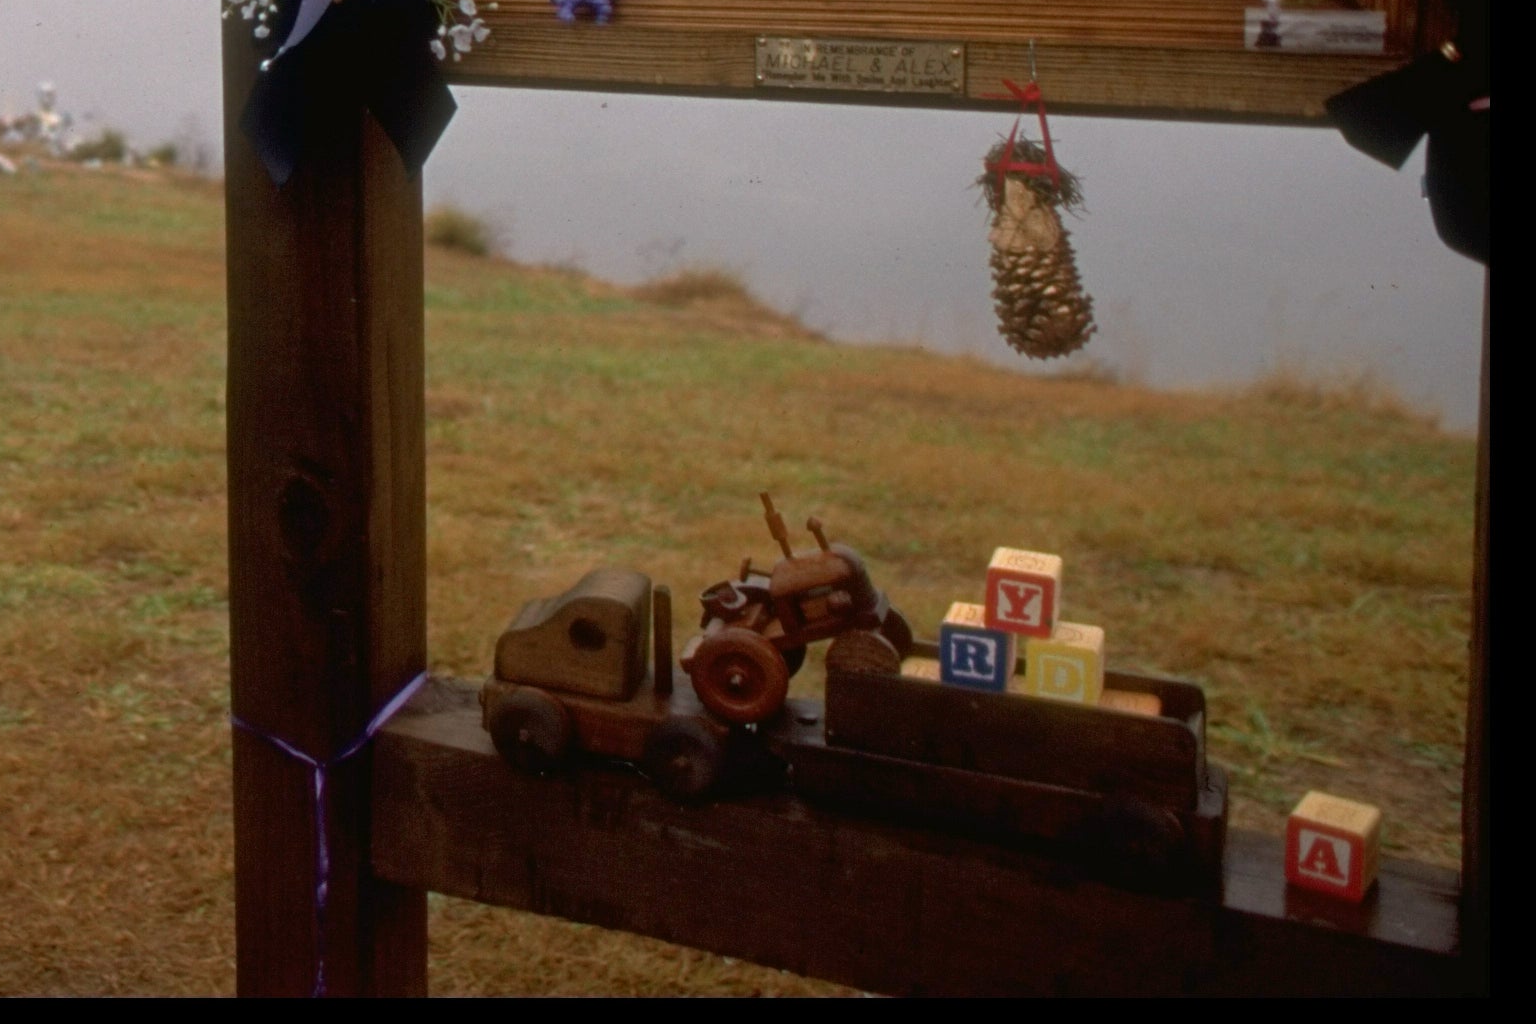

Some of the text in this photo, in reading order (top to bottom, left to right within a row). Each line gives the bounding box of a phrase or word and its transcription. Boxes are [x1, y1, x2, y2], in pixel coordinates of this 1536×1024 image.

[766, 53, 951, 76] MICHAEL & ALEX
[816, 43, 897, 57] REMEMBRANCE
[901, 46, 916, 57] OF
[999, 584, 1041, 622] Y
[951, 638, 995, 676] R
[1040, 656, 1083, 696] D
[1298, 836, 1346, 881] A
